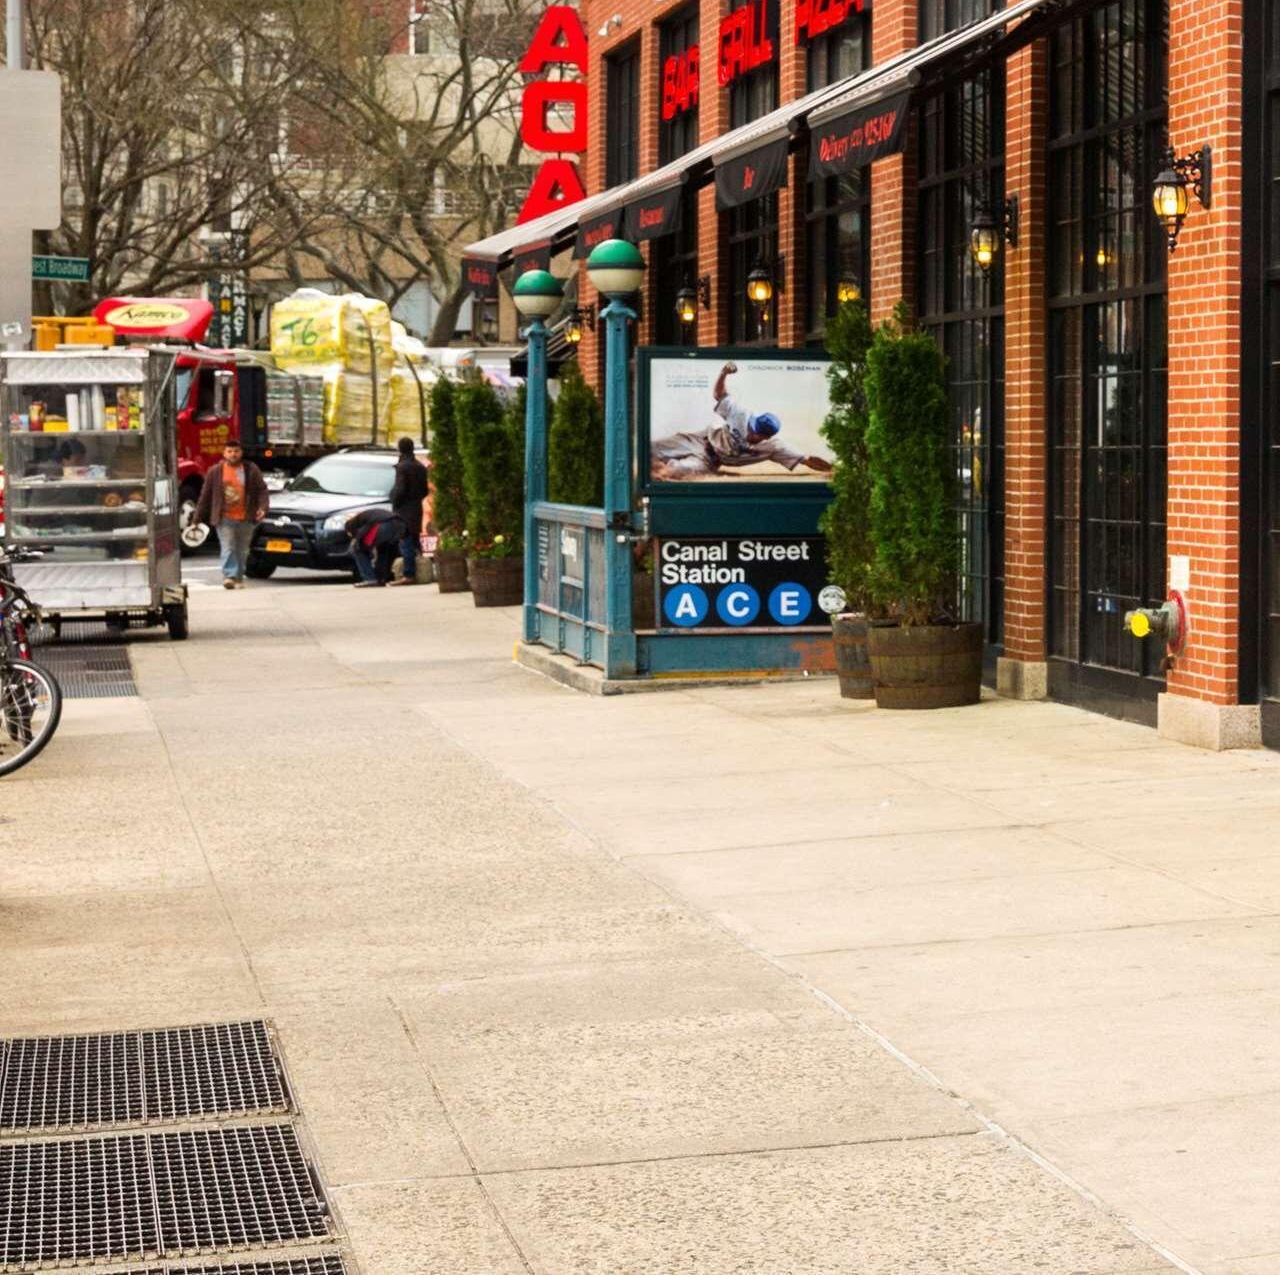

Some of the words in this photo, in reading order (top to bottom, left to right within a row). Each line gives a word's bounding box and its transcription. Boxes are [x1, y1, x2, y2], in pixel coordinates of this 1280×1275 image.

[662, 44, 700, 122] BAR
[661, 540, 728, 563] Canal
[738, 540, 810, 562] Street
[661, 563, 746, 585] Station
[675, 592, 699, 619] A
[726, 591, 750, 618] C
[780, 591, 800, 617] E
